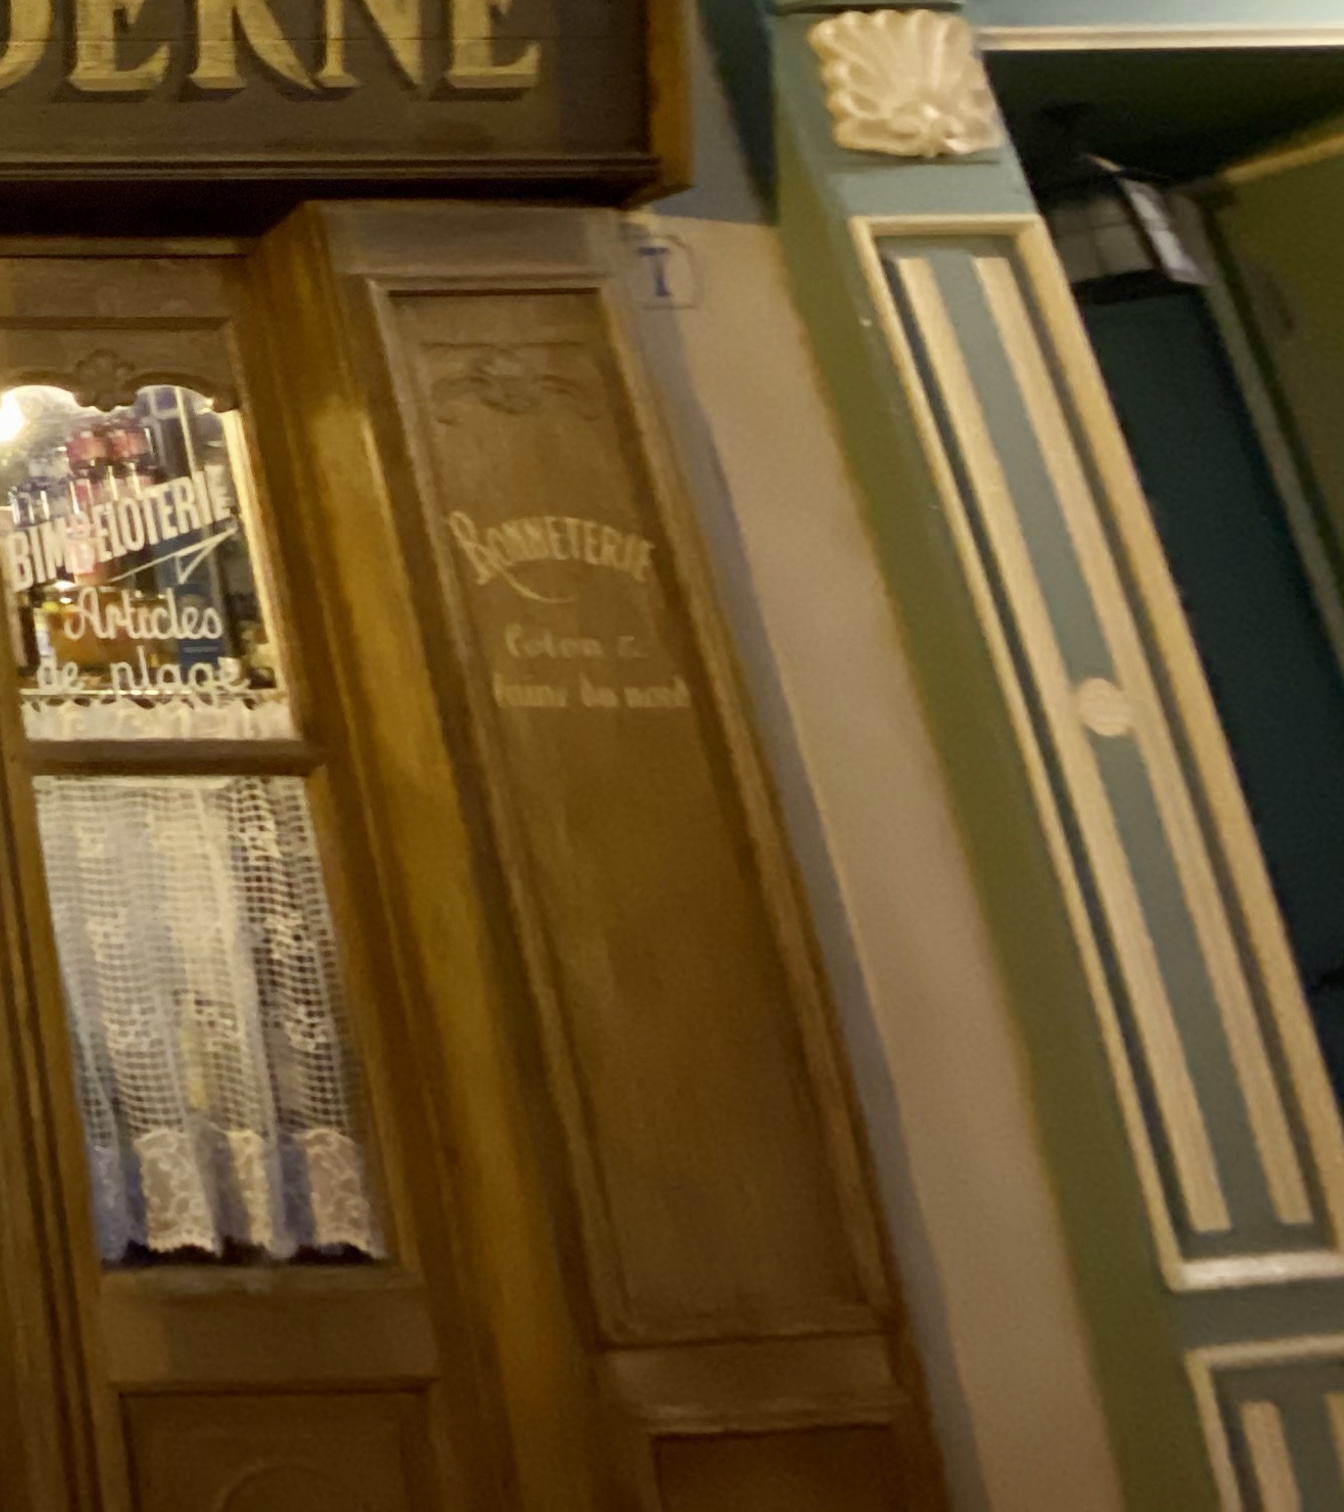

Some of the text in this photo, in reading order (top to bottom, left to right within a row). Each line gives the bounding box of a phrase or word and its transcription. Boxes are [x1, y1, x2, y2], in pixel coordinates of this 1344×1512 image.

[4, 465, 231, 593] BIMBELOTERIE
[63, 588, 223, 639] Articles
[37, 660, 84, 688] de
